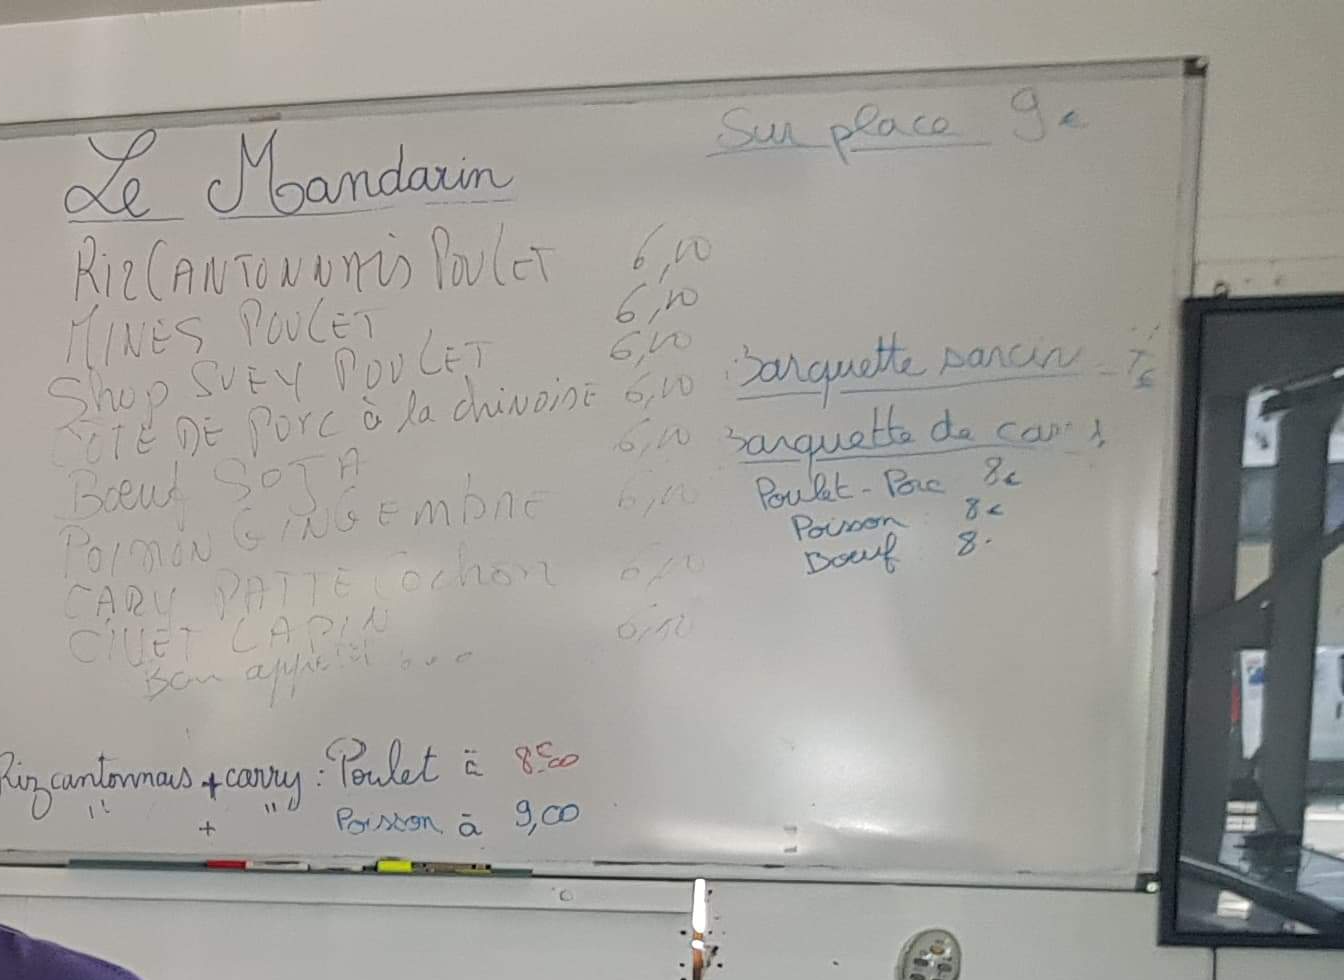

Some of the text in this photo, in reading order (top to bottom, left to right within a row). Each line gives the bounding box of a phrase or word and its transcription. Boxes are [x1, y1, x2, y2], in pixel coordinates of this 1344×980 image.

[829, 104, 961, 166] place
[65, 128, 513, 219] Le Mandarin
[325, 737, 441, 788] Poulet
[515, 799, 581, 837] 9,00
